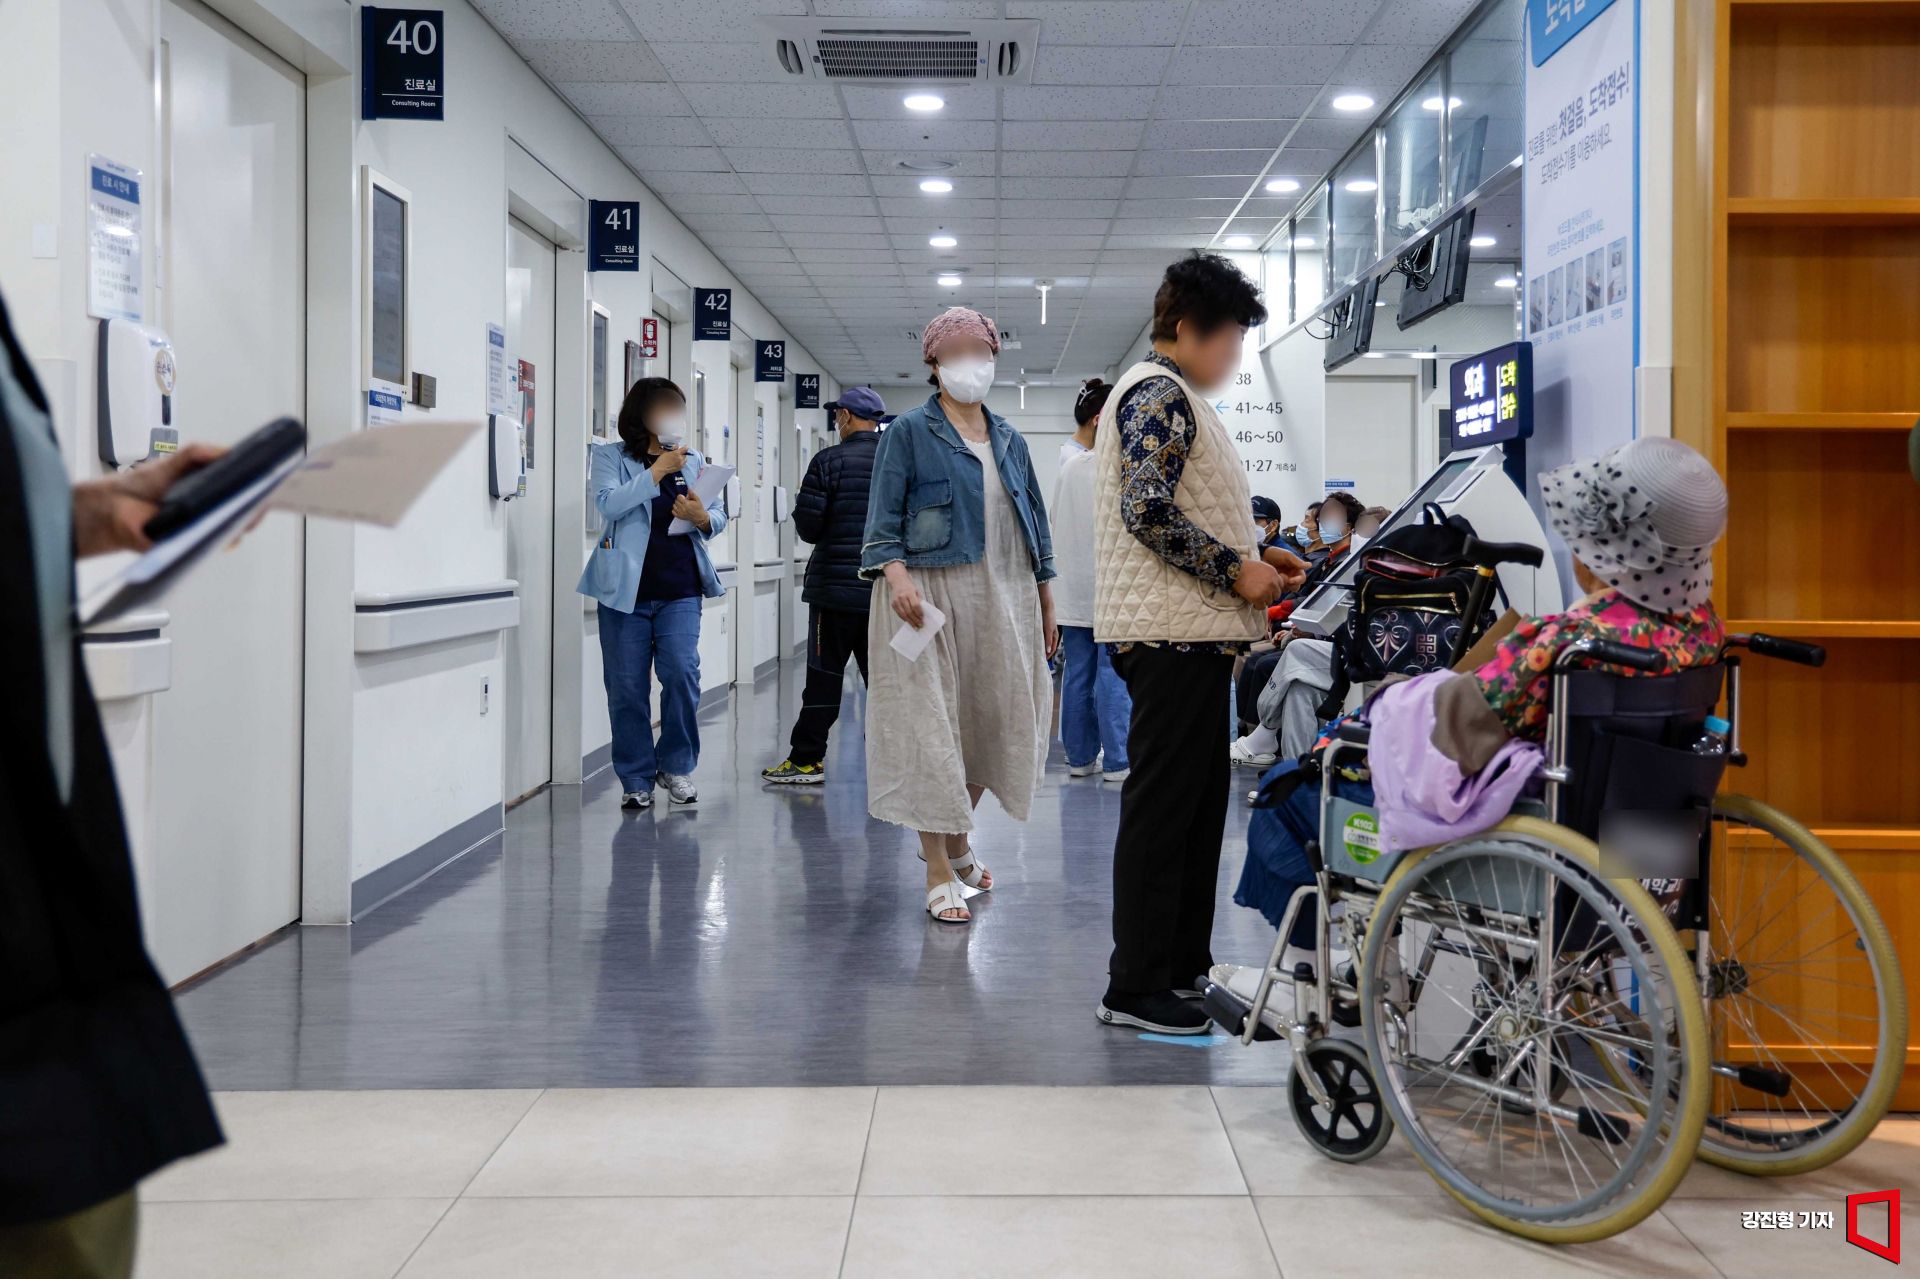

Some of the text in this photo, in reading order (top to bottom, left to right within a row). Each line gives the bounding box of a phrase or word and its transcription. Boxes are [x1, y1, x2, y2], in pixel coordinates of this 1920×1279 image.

[387, 20, 437, 55] 40
[405, 78, 436, 92] 진료실
[391, 99, 420, 108] Consulting
[1528, 130, 1545, 162] 진료를
[1588, 60, 1630, 117] 도착접수!
[1541, 144, 1576, 185] 도착접수기를
[605, 208, 631, 230] 41
[614, 245, 635, 254] 진료실
[705, 294, 728, 311] 42
[764, 344, 782, 358] 43
[1500, 360, 1517, 387] 도착
[802, 377, 818, 389] 44
[1275, 463, 1297, 472] 계측실
